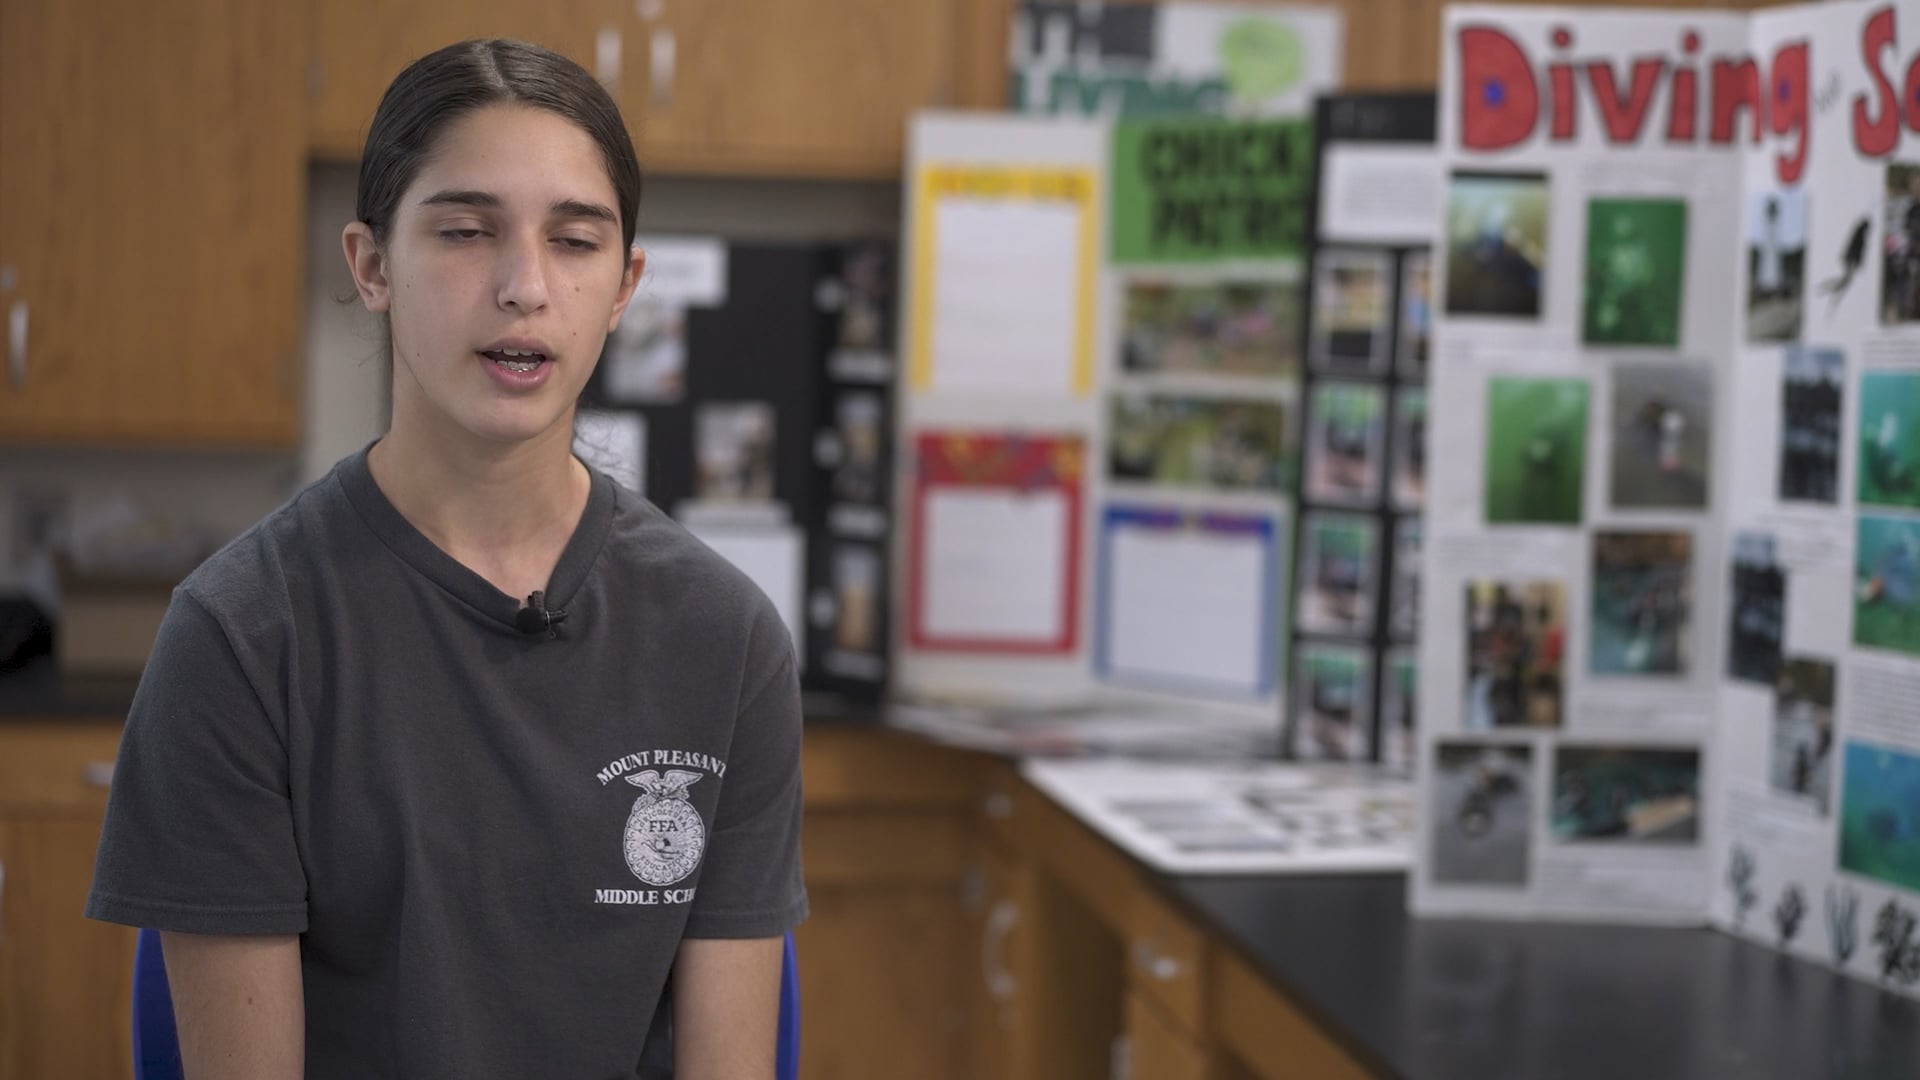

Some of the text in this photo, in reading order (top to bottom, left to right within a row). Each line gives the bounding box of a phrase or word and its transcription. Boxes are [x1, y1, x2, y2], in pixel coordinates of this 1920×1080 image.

[1457, 24, 1811, 186] Diving
[596, 750, 727, 786] MOUNT PLEASANT
[649, 820, 679, 833] FFA
[594, 889, 659, 904] MIDDLE
